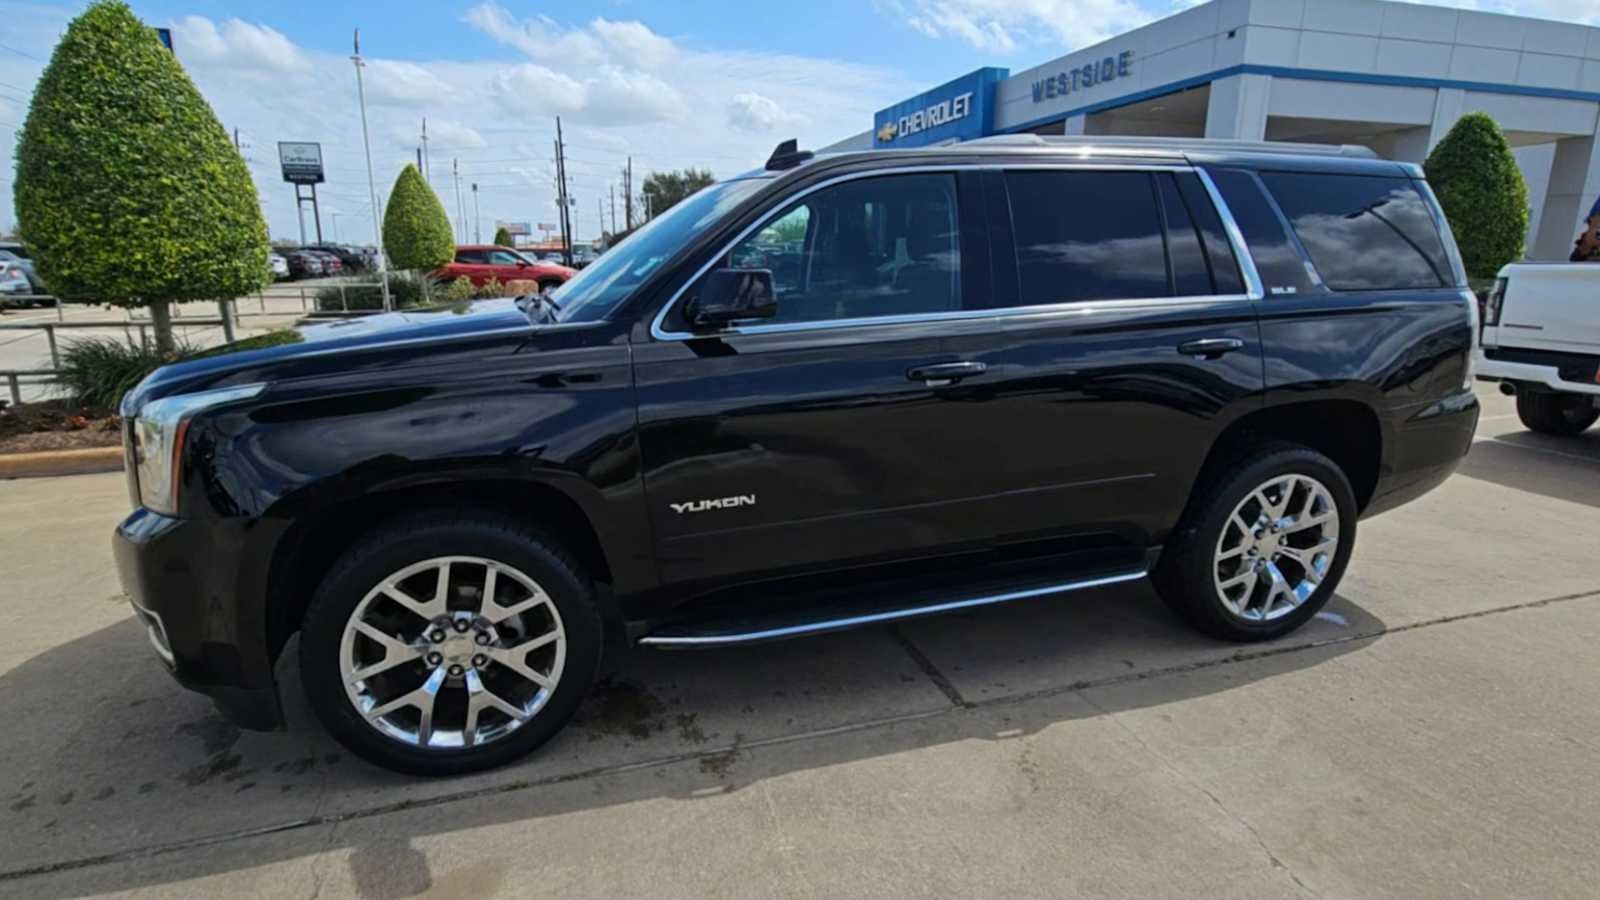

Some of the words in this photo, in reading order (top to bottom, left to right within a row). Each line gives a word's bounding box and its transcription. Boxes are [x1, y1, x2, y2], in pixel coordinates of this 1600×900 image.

[1031, 50, 1135, 103] WESTSIDE
[898, 91, 974, 137] CHEVROLET
[669, 494, 756, 514] YUKON
